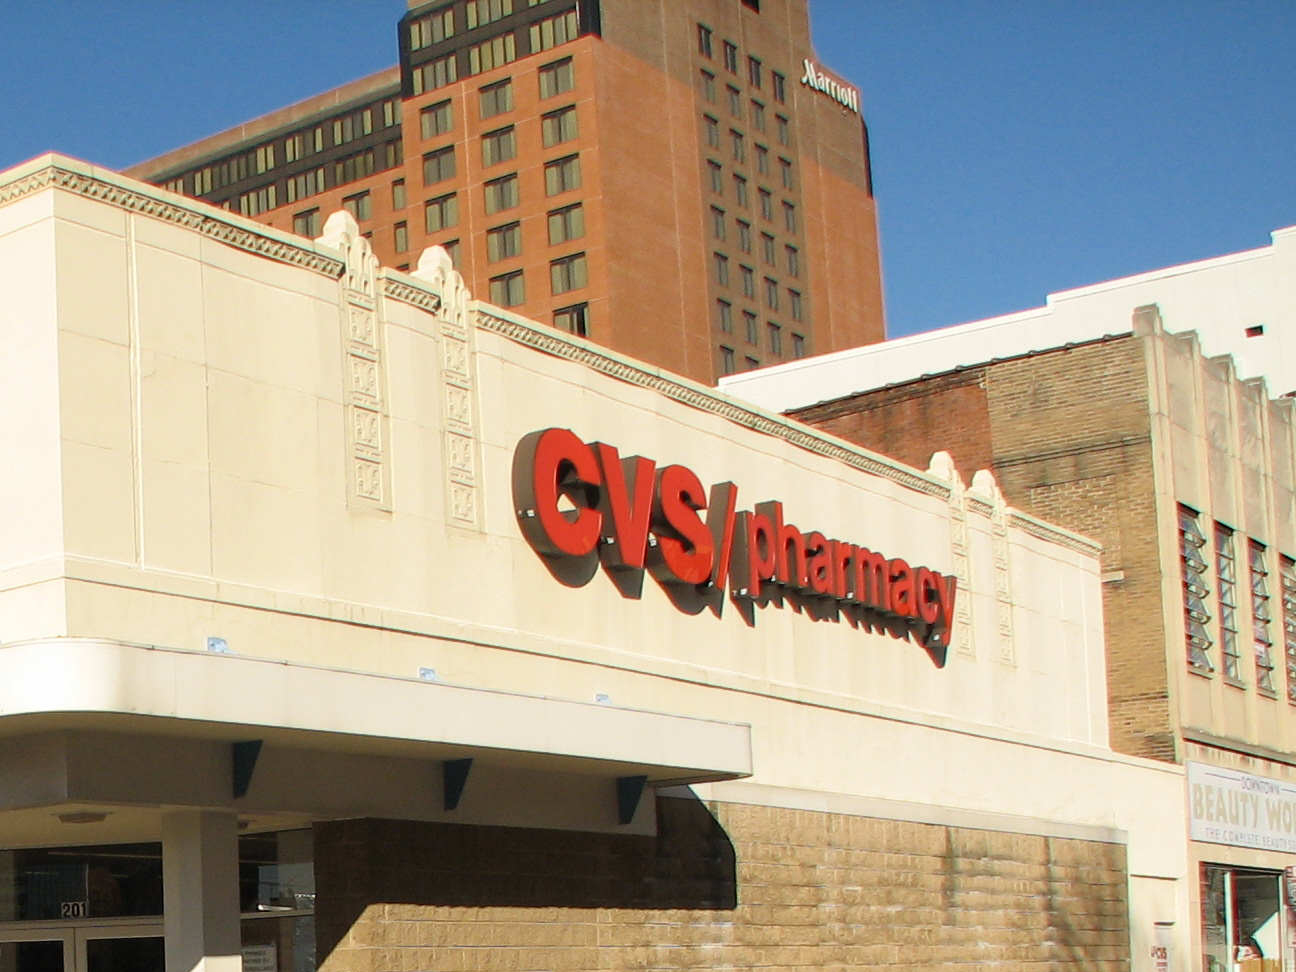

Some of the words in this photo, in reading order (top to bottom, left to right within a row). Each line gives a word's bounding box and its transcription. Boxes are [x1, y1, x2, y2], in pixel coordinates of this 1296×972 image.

[801, 58, 857, 112] Marriott
[514, 428, 957, 646] CVS/pharmacy
[1192, 783, 1258, 829] BEAUTY
[1241, 776, 1280, 795] DOWNTOWN
[62, 902, 87, 918] 201
